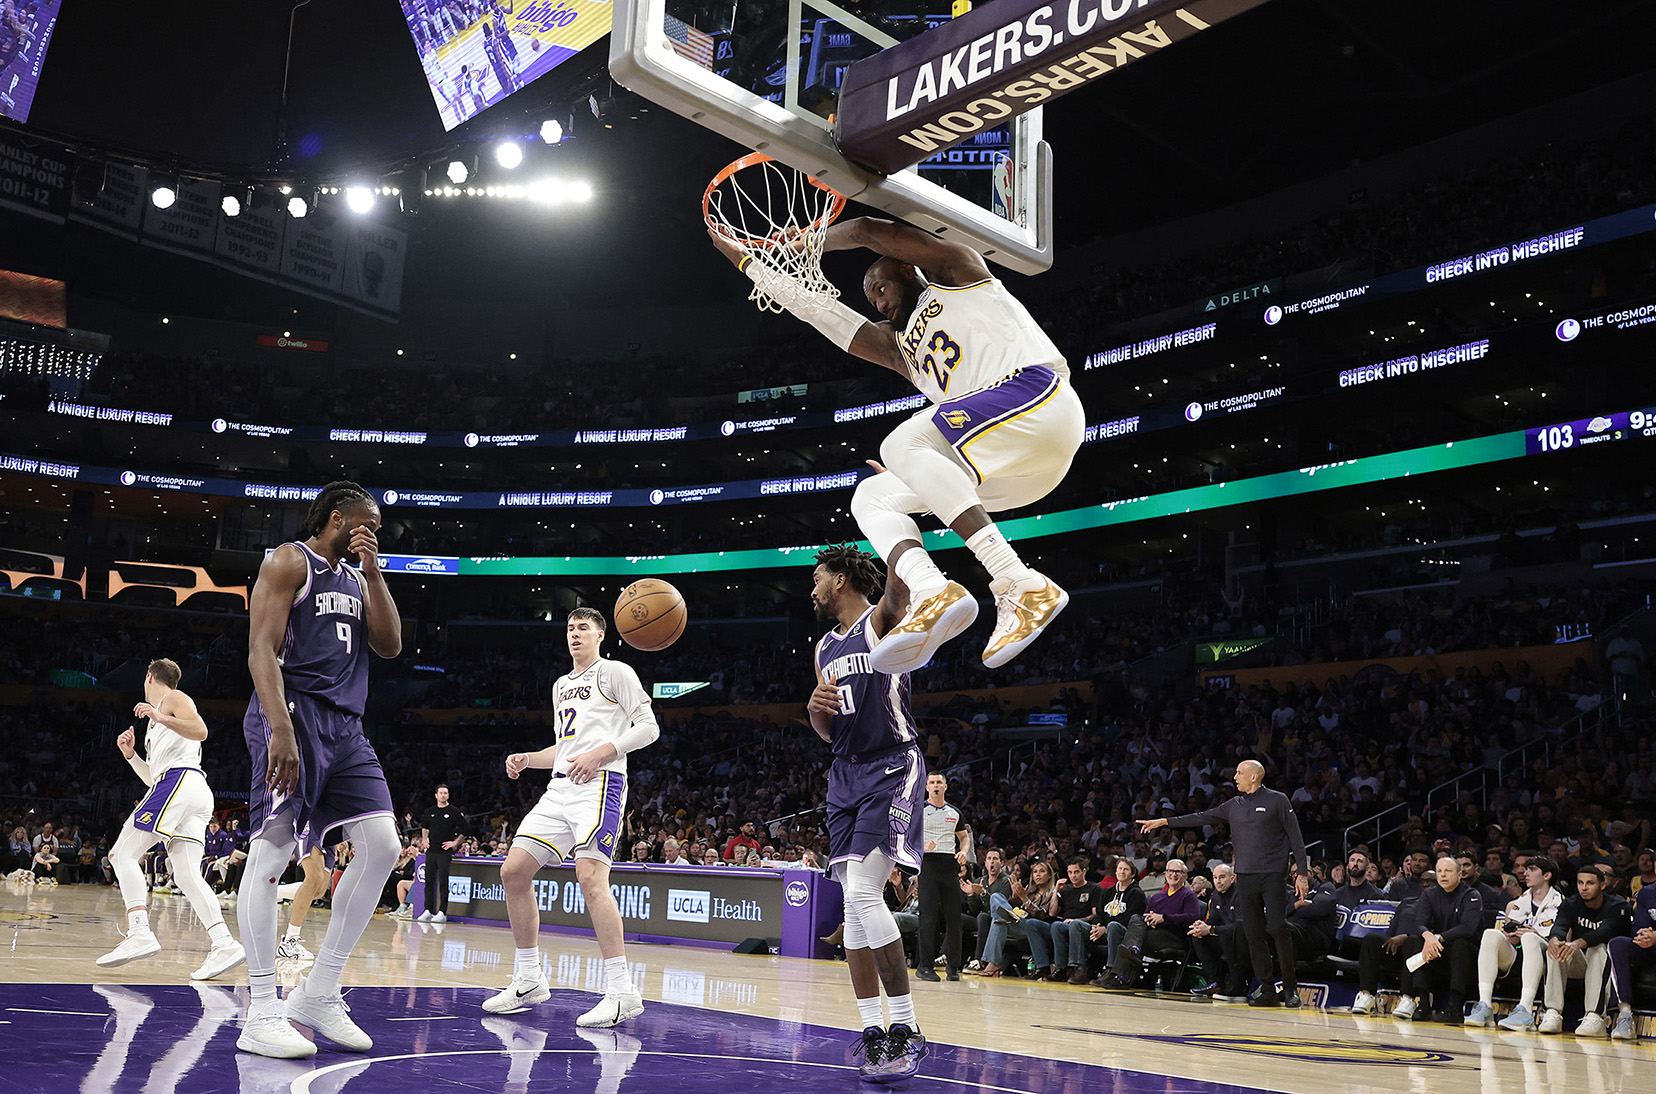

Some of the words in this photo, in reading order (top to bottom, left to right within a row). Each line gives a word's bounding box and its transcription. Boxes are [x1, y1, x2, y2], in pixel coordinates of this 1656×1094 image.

[516, 0, 578, 33] bibigo
[885, 0, 1149, 121] LAKERS.CO
[1425, 256, 1473, 283] CHECK
[1475, 246, 1509, 271] INTO
[1512, 226, 1584, 261] MISCHIEF
[1220, 284, 1270, 307] DELTA
[1284, 303, 1299, 314] THE
[1583, 316, 1604, 329] THE
[1606, 304, 1656, 325] COSMOP
[1084, 356, 1093, 371] A
[1093, 344, 1132, 368] UNIQUE
[1132, 333, 1174, 359] LUXURY
[1174, 322, 1217, 347] RESORT
[922, 329, 963, 395] 23
[1339, 358, 1384, 387] CHECK
[1386, 350, 1418, 378] INTO
[1421, 339, 1489, 371] MISCHIEF
[47, 401, 56, 413] A
[57, 402, 96, 419] UNIQUE
[96, 407, 134, 423] LUXURY
[134, 411, 173, 427] RESORT
[834, 404, 864, 423] CHECK
[864, 399, 885, 419] INTO
[885, 394, 927, 415] MISCHIEF
[1203, 402, 1219, 412] THE
[227, 422, 240, 431] THE
[574, 431, 582, 444] A
[582, 429, 617, 444] UNIQUE
[617, 427, 653, 443] LUXURY
[653, 425, 688, 441] RESORT
[1100, 416, 1140, 439] RESORT
[1615, 430, 1622, 440] 3
[329, 429, 360, 442] CHECK
[361, 429, 383, 444] INTO
[383, 430, 427, 445] MISCHIEF
[479, 435, 490, 443] THE
[1537, 424, 1574, 452] 103
[1579, 434, 1611, 445] TIMEOUTS
[0, 456, 39, 474] LUXURY
[39, 461, 80, 479] RESORT
[137, 474, 150, 482] THE
[760, 480, 791, 495] CHECK
[792, 477, 815, 492] INTO
[815, 471, 858, 490] MISCHIEF
[244, 484, 278, 499] CHECK
[278, 486, 301, 500] INTO
[399, 493, 411, 501] THE
[498, 494, 506, 506] A
[507, 493, 540, 506] UNIQUE
[541, 492, 577, 506] LUXURY
[577, 491, 612, 505] RESORT
[664, 490, 676, 498] THE
[335, 621, 352, 655] 9
[662, 686, 678, 694] UCLA
[837, 684, 856, 716] 0
[558, 707, 577, 740] 12
[214, 790, 250, 800] AMPIONS
[888, 806, 912, 824] KINGS
[449, 882, 468, 896] CLA
[472, 882, 506, 902] Health
[531, 879, 559, 912] EEP
[609, 883, 651, 920] SING
[673, 897, 704, 914] UCLA
[712, 897, 762, 922] Health
[1364, 912, 1391, 925] PRIME
